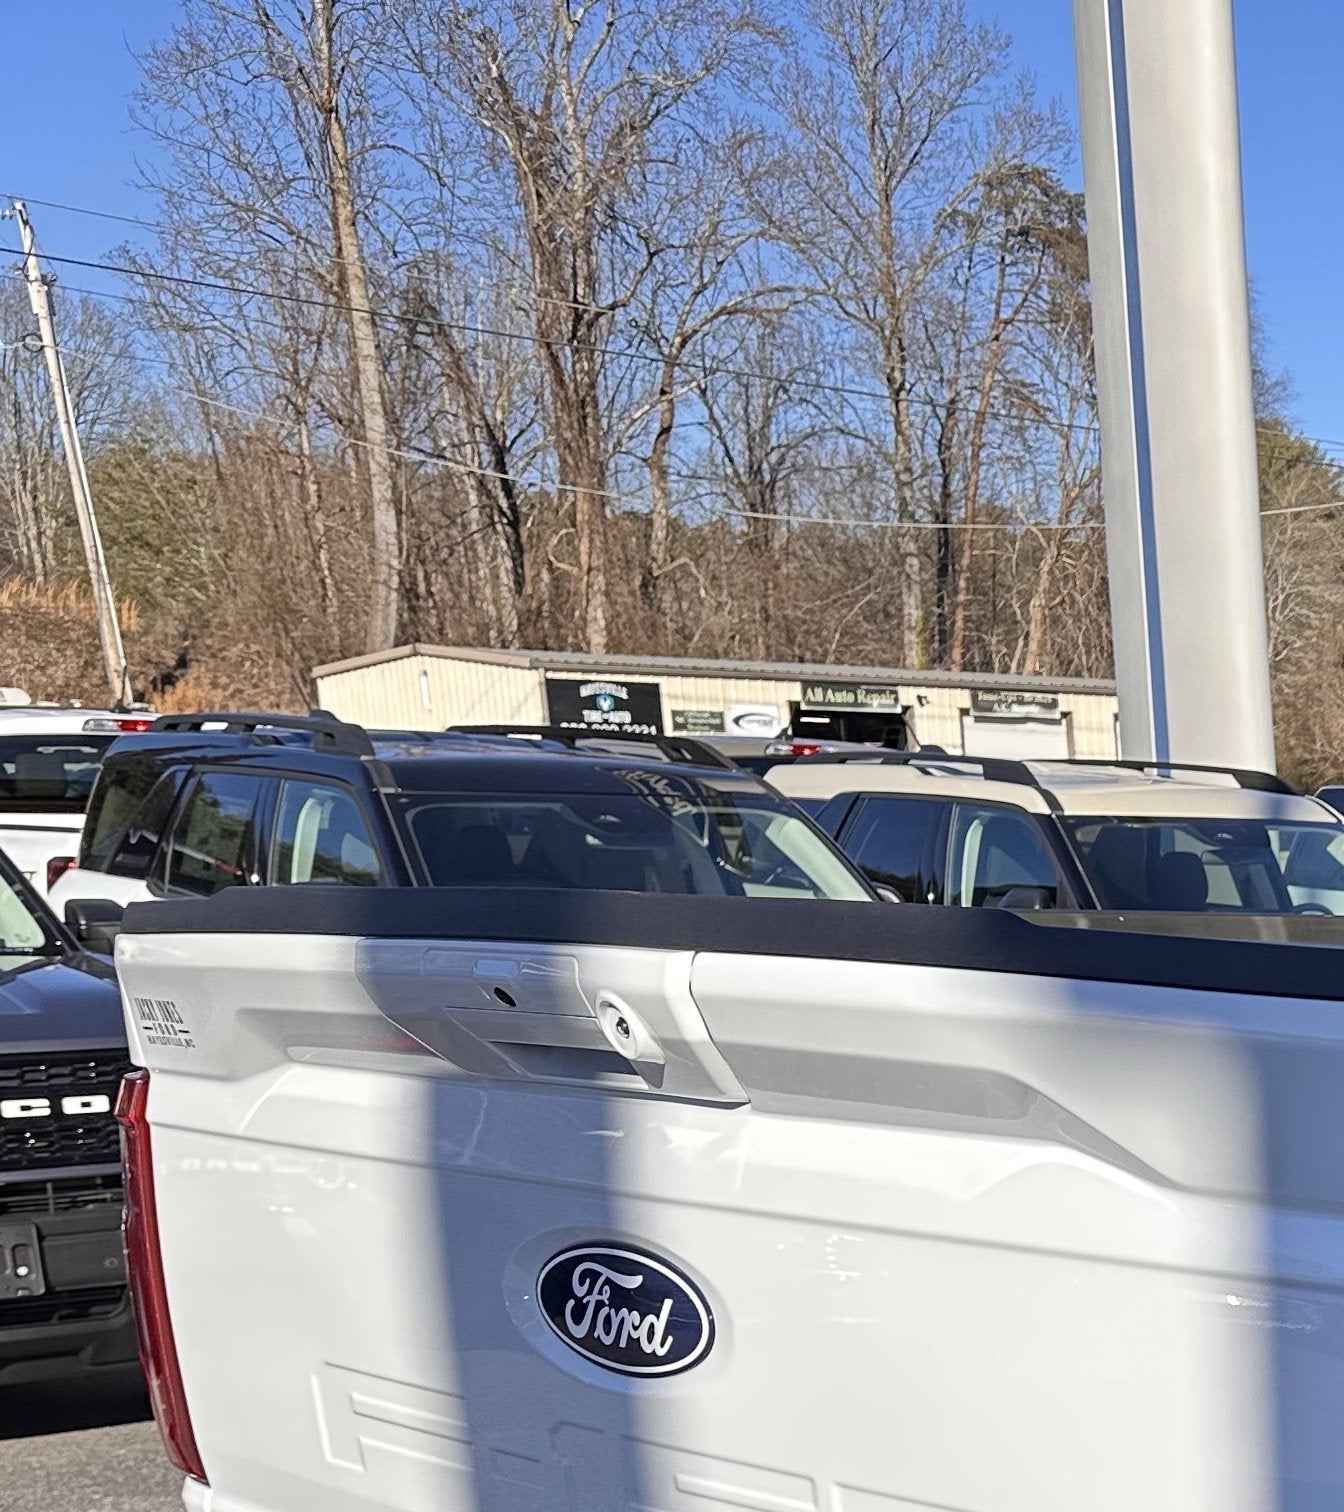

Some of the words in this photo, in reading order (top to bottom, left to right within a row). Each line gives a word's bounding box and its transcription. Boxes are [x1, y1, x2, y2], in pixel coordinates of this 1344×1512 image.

[804, 687, 824, 702] All
[825, 688, 855, 703] Auto
[565, 1262, 674, 1357] Ford
